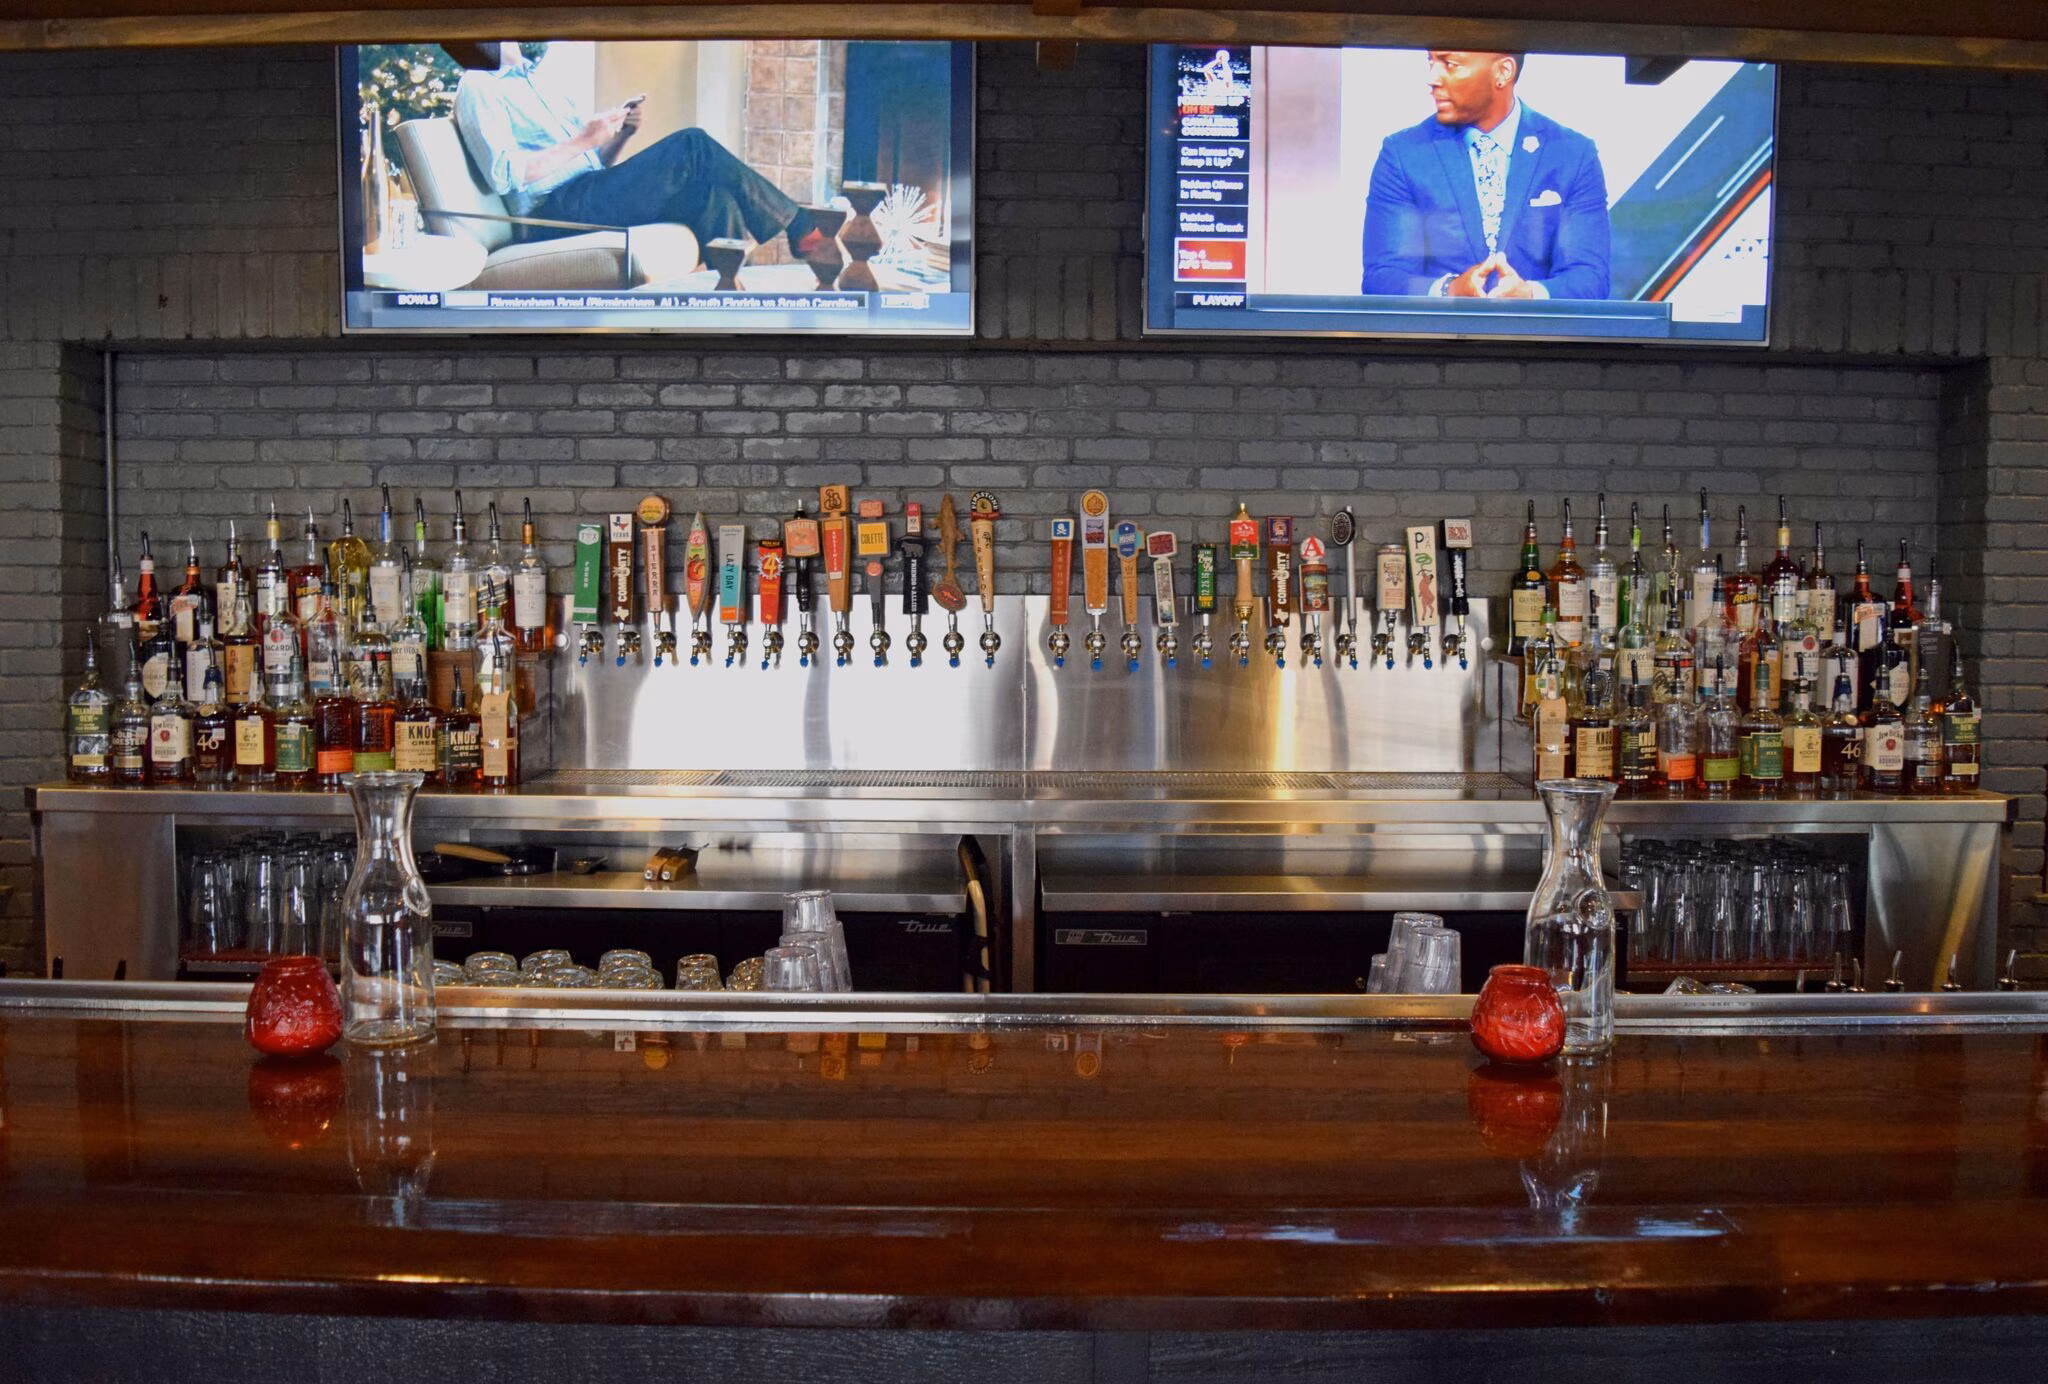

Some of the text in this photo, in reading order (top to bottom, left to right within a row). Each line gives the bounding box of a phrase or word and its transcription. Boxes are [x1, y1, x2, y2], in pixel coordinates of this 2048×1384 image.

[398, 294, 438, 305] BOWLS
[1193, 295, 1244, 306] PLAYOFF
[860, 532, 884, 544] COLETTE
[725, 553, 735, 590] LAZY DAY
[1277, 551, 1289, 605] COMMUNITY
[196, 734, 219, 751] 46
[450, 731, 477, 745] KNOB
[1841, 742, 1862, 759] 46
